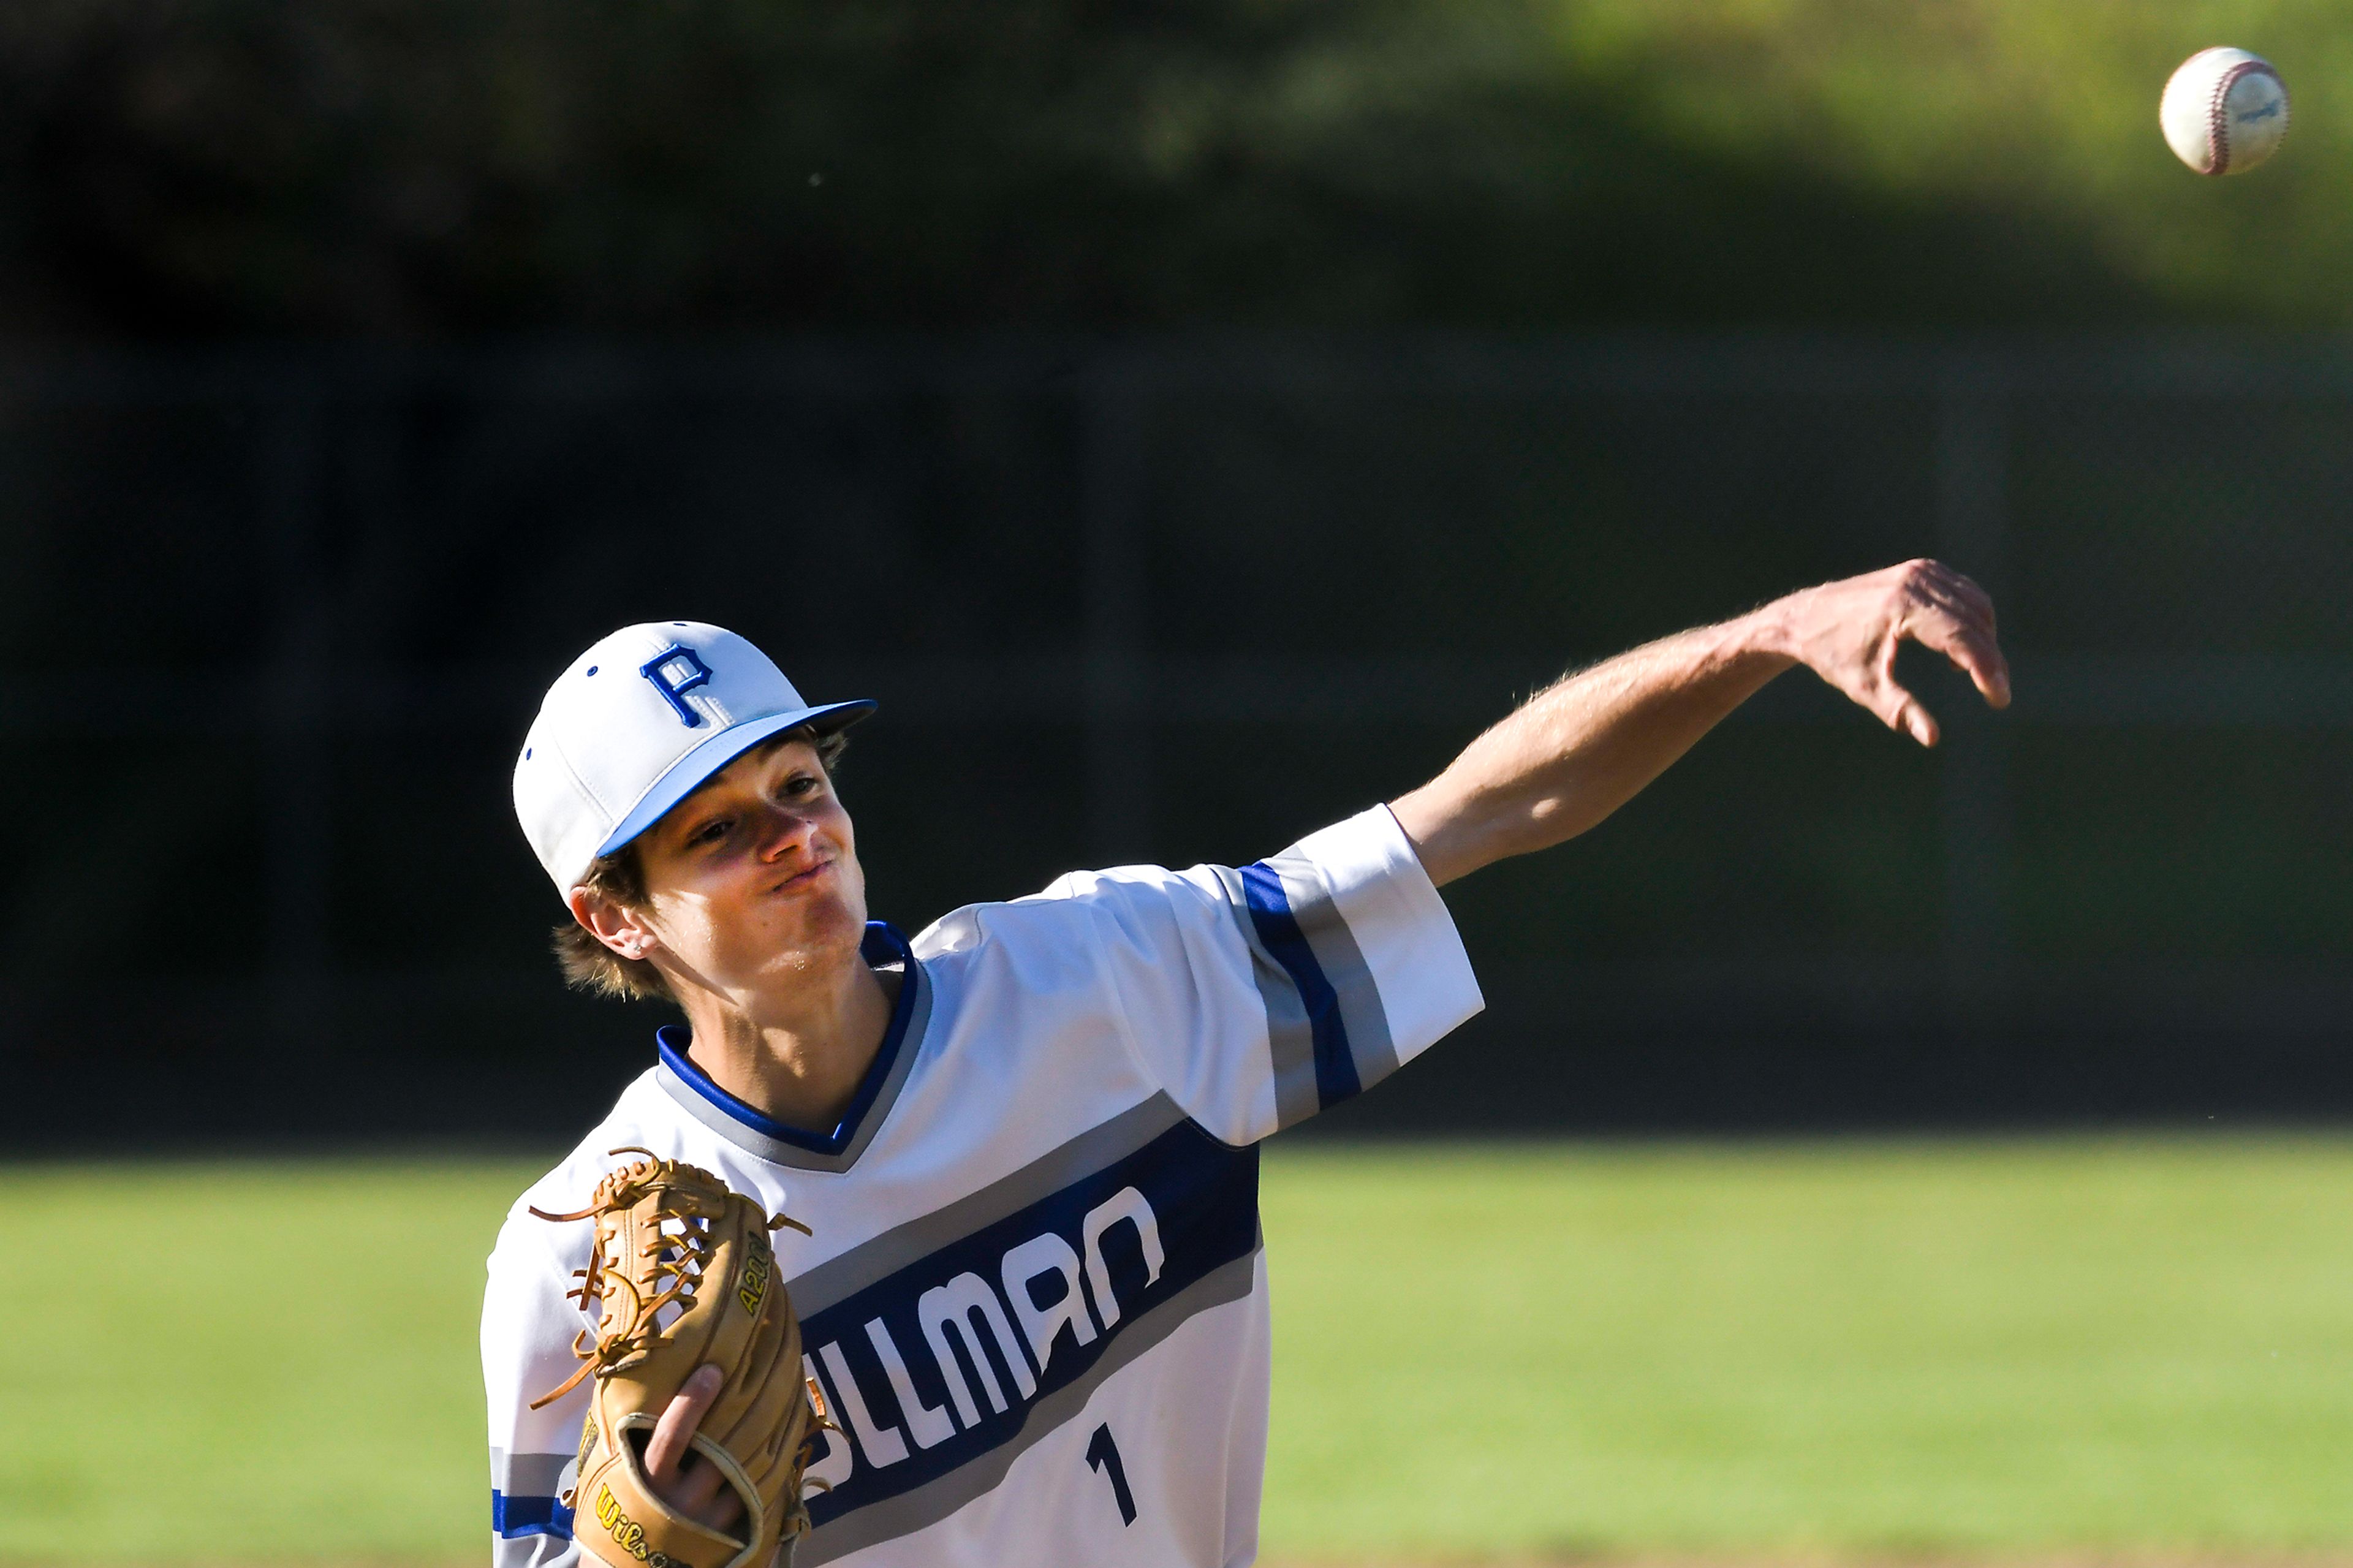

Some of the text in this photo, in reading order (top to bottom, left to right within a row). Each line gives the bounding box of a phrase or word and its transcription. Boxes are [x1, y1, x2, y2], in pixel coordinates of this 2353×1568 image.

[640, 643, 713, 729] P
[800, 1186, 1165, 1502] ULLMAN
[1085, 1422, 1137, 1528] 1
